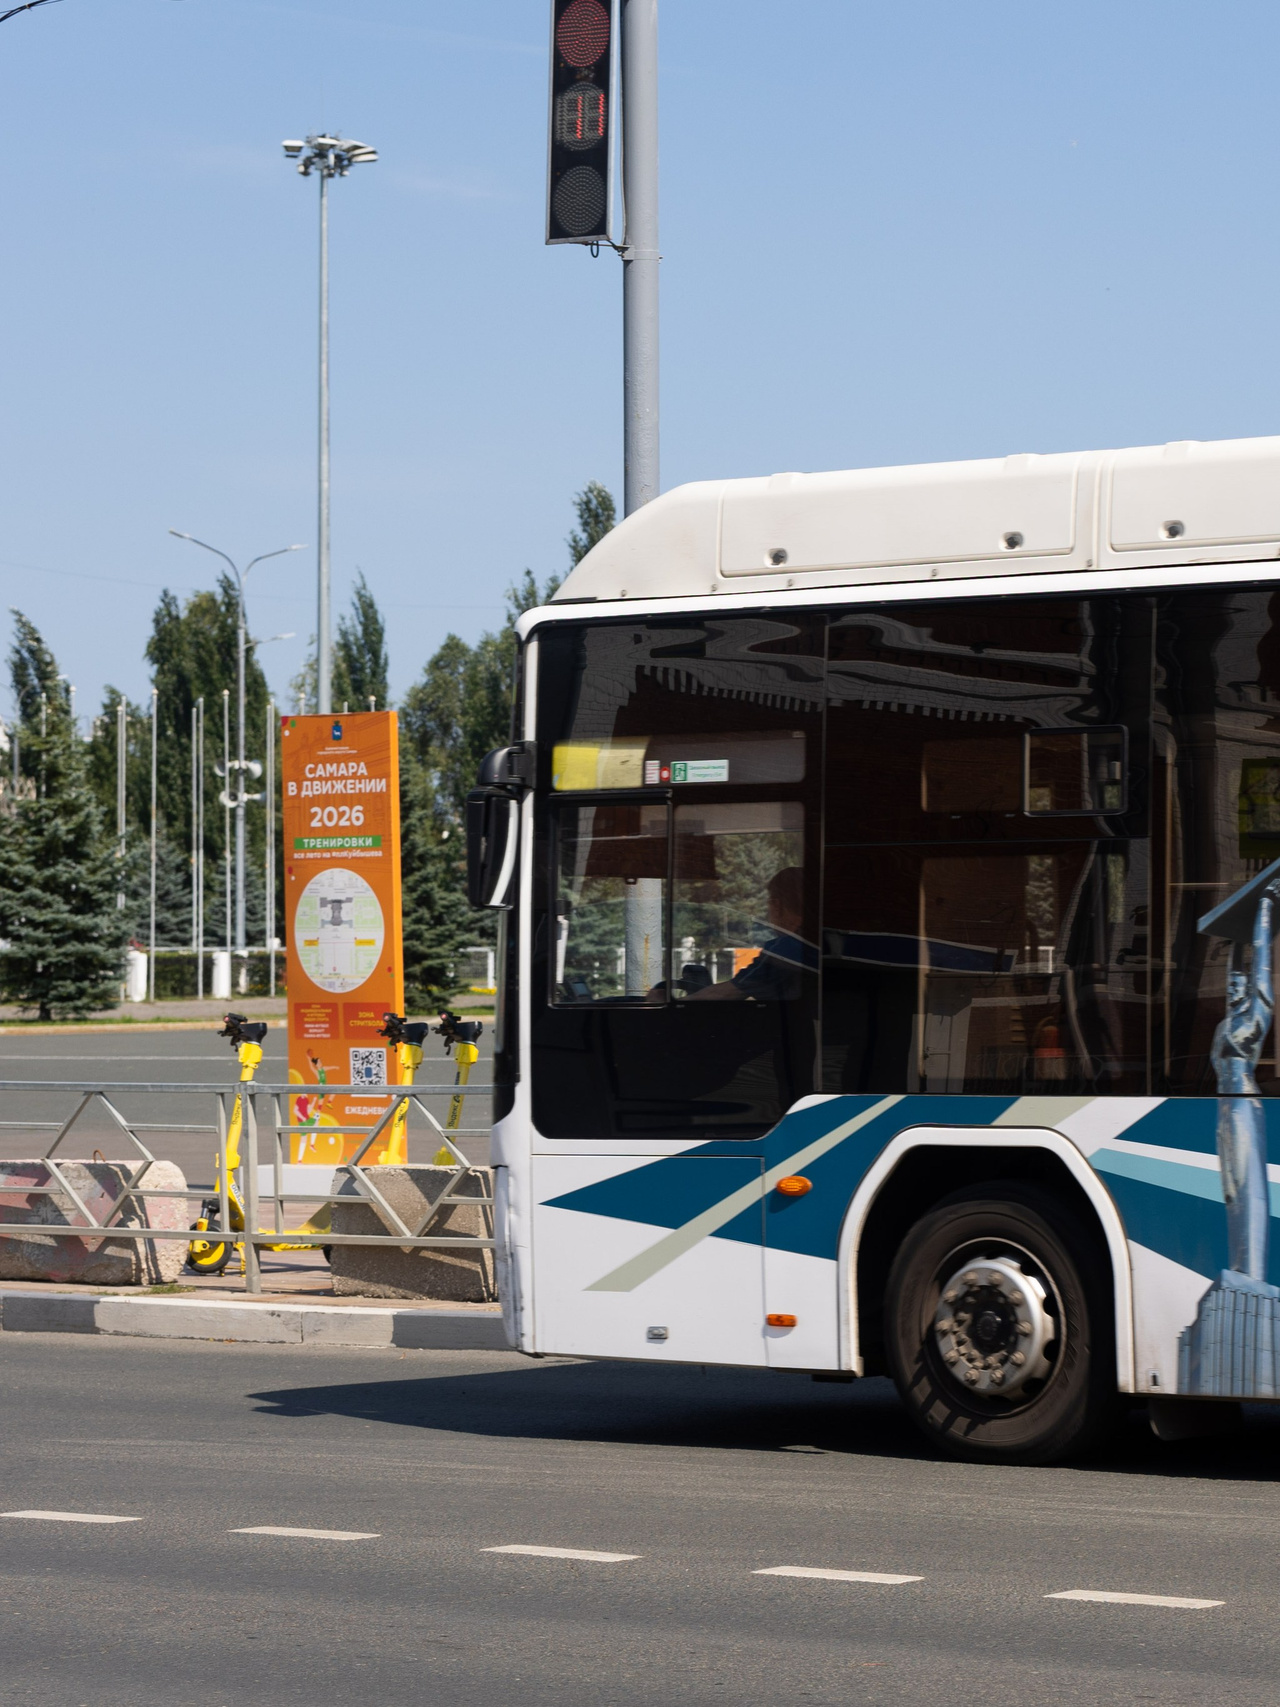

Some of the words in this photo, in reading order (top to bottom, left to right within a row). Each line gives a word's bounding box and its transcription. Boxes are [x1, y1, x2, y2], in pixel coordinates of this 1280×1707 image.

[305, 762, 368, 778] САМАРА
[288, 782, 297, 796] В
[301, 778, 387, 797] ДВИЖЕНИИ
[310, 805, 364, 827] 2026
[303, 837, 373, 848] ТРЕНИРОВКИ
